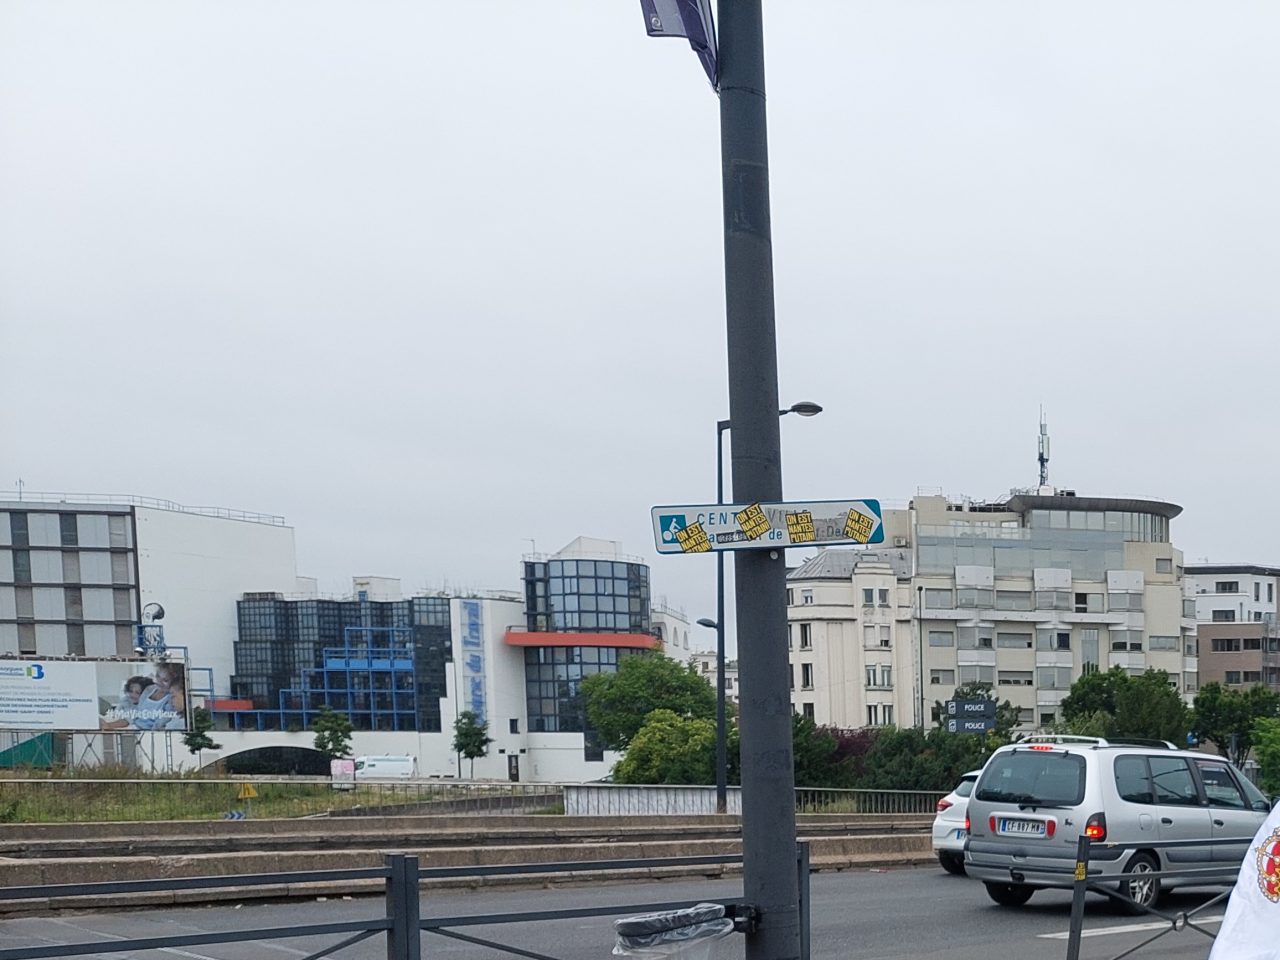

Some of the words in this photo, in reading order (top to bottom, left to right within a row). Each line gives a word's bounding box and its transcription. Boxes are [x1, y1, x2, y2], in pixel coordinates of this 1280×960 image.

[737, 512, 748, 524] ON
[746, 503, 761, 517] EST
[786, 515, 796, 524] ON
[798, 513, 811, 523] EST
[849, 509, 859, 520] ON
[860, 515, 873, 527] EST
[741, 514, 766, 531] NANTES
[789, 523, 813, 533] NANTES
[847, 519, 870, 536] NANTES
[676, 530, 688, 542] ON
[687, 523, 702, 537] EST
[681, 532, 707, 551] NANTES
